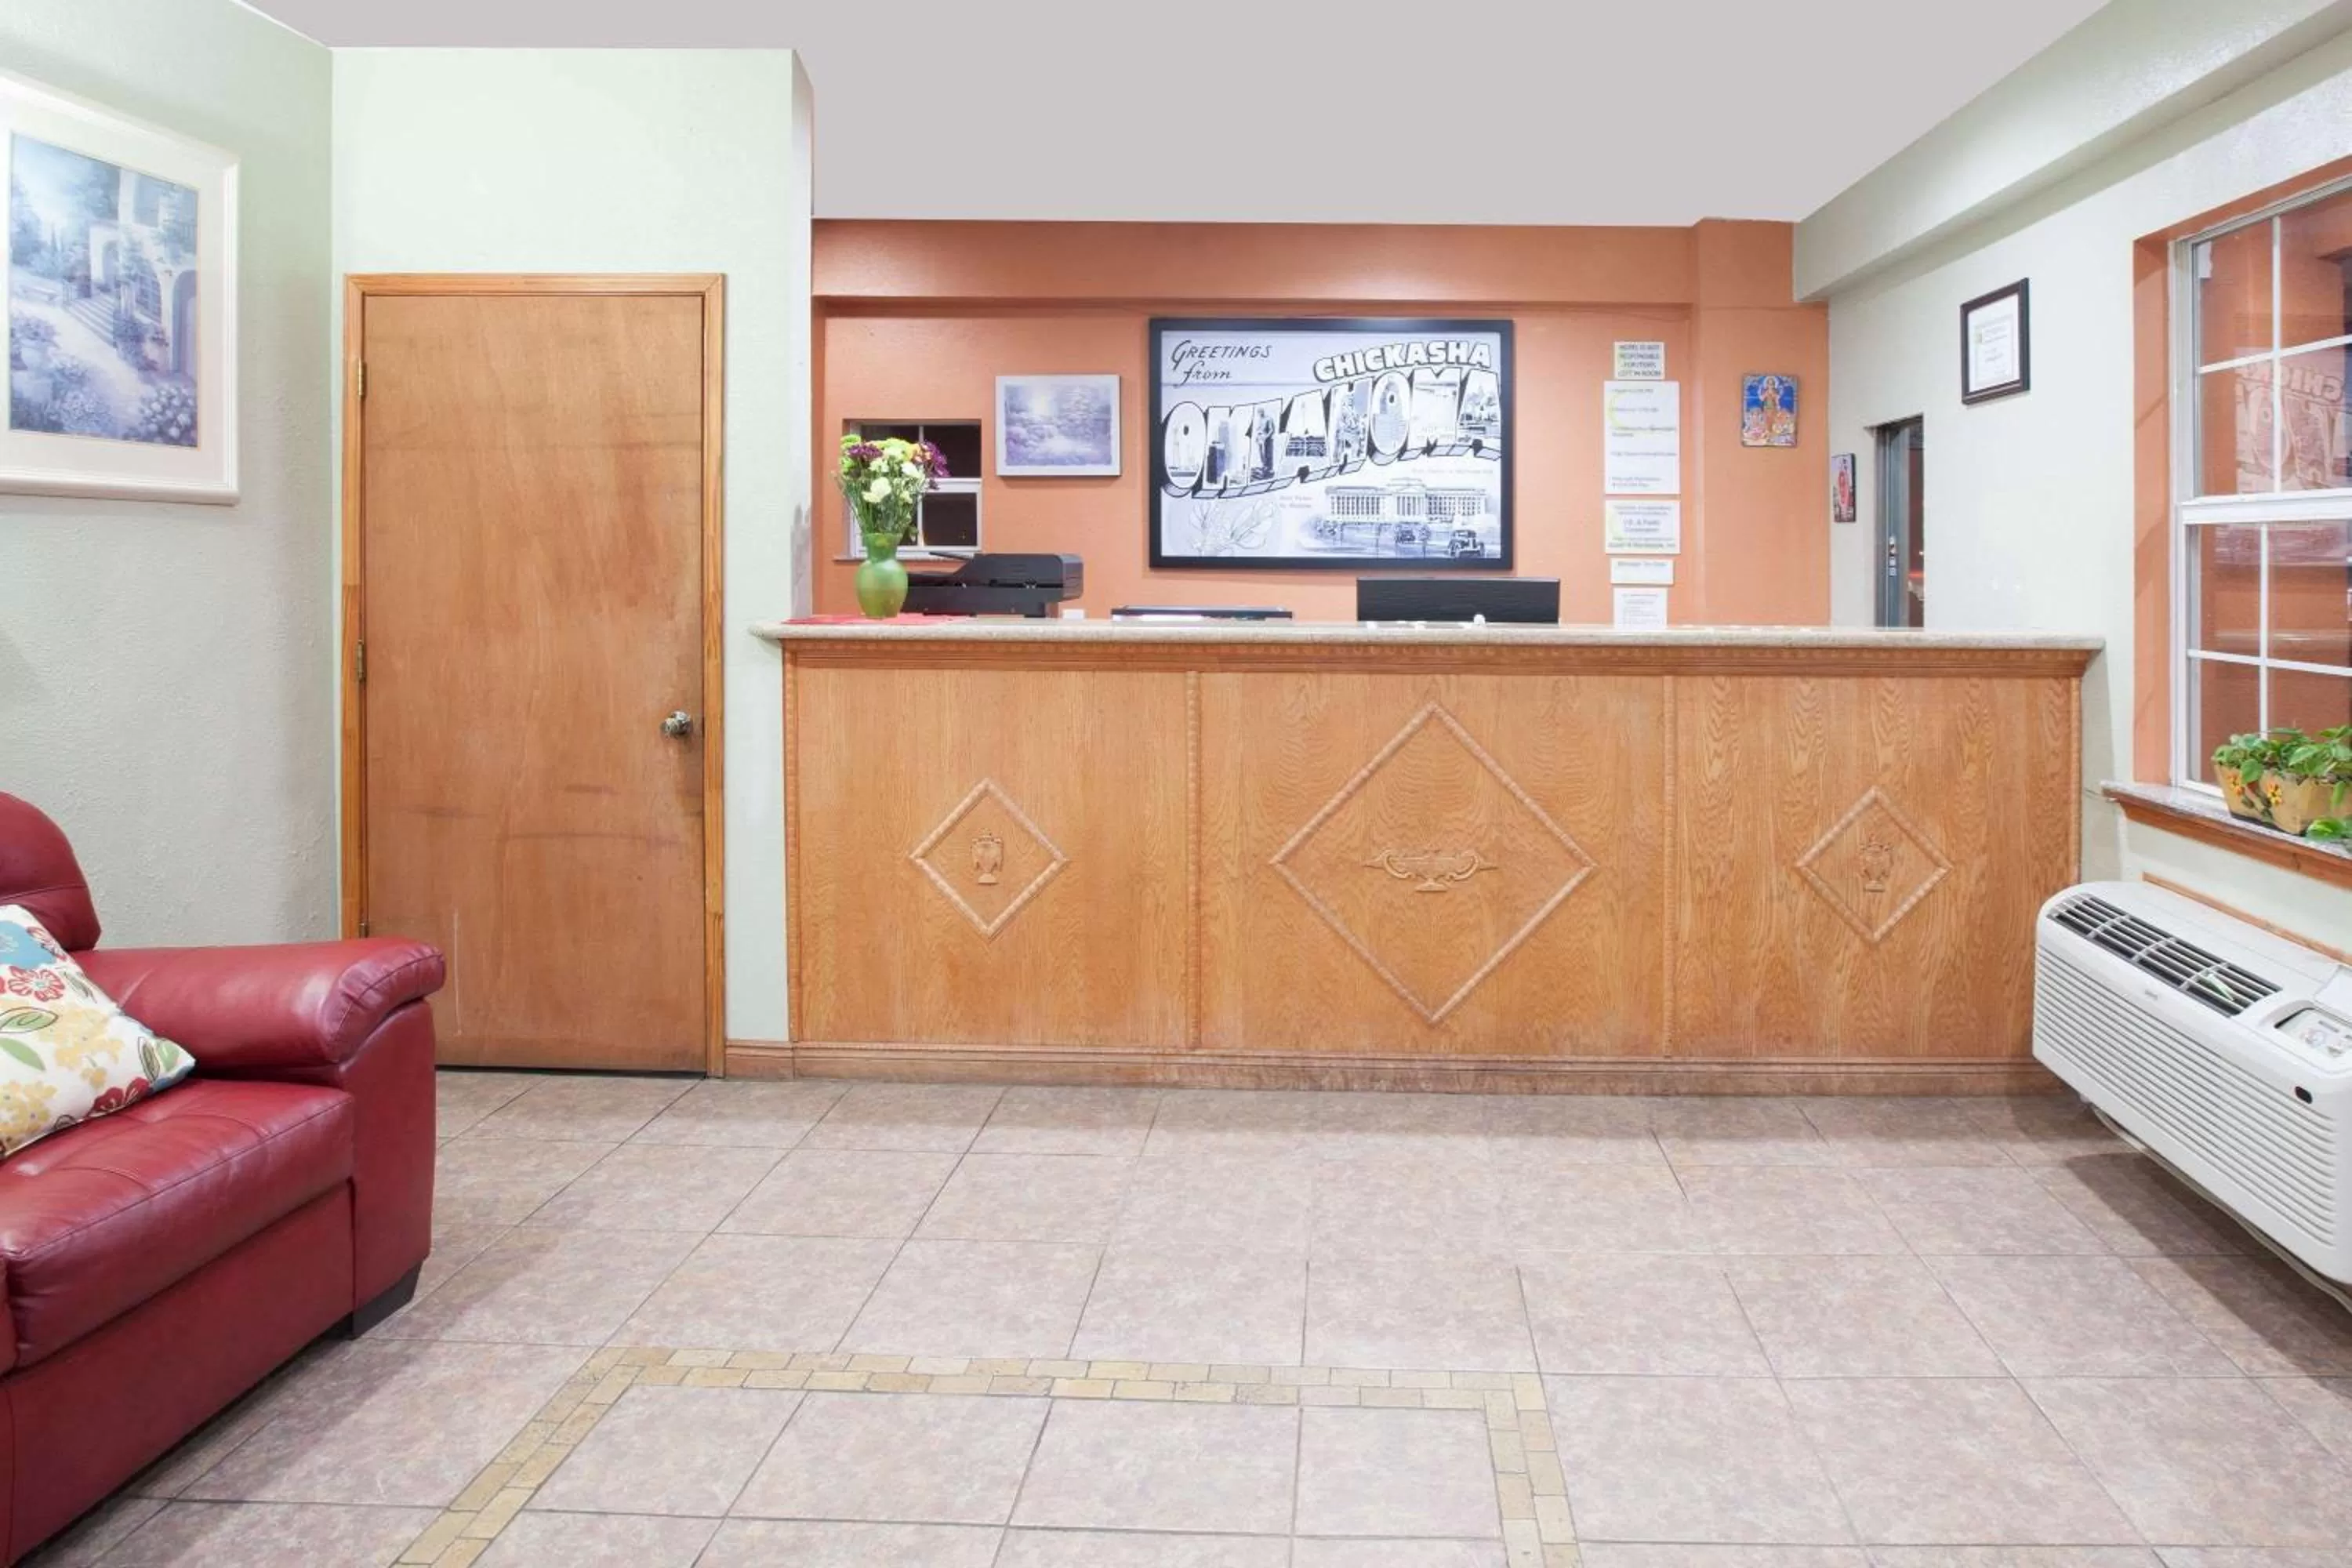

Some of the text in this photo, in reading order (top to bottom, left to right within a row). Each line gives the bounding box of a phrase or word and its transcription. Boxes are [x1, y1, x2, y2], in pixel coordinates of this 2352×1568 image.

[1171, 339, 1272, 371] GREETINGS
[1313, 340, 1491, 383] CHICKASHA
[1174, 360, 1231, 388] from
[1162, 367, 1501, 499] OKLAHOMA
